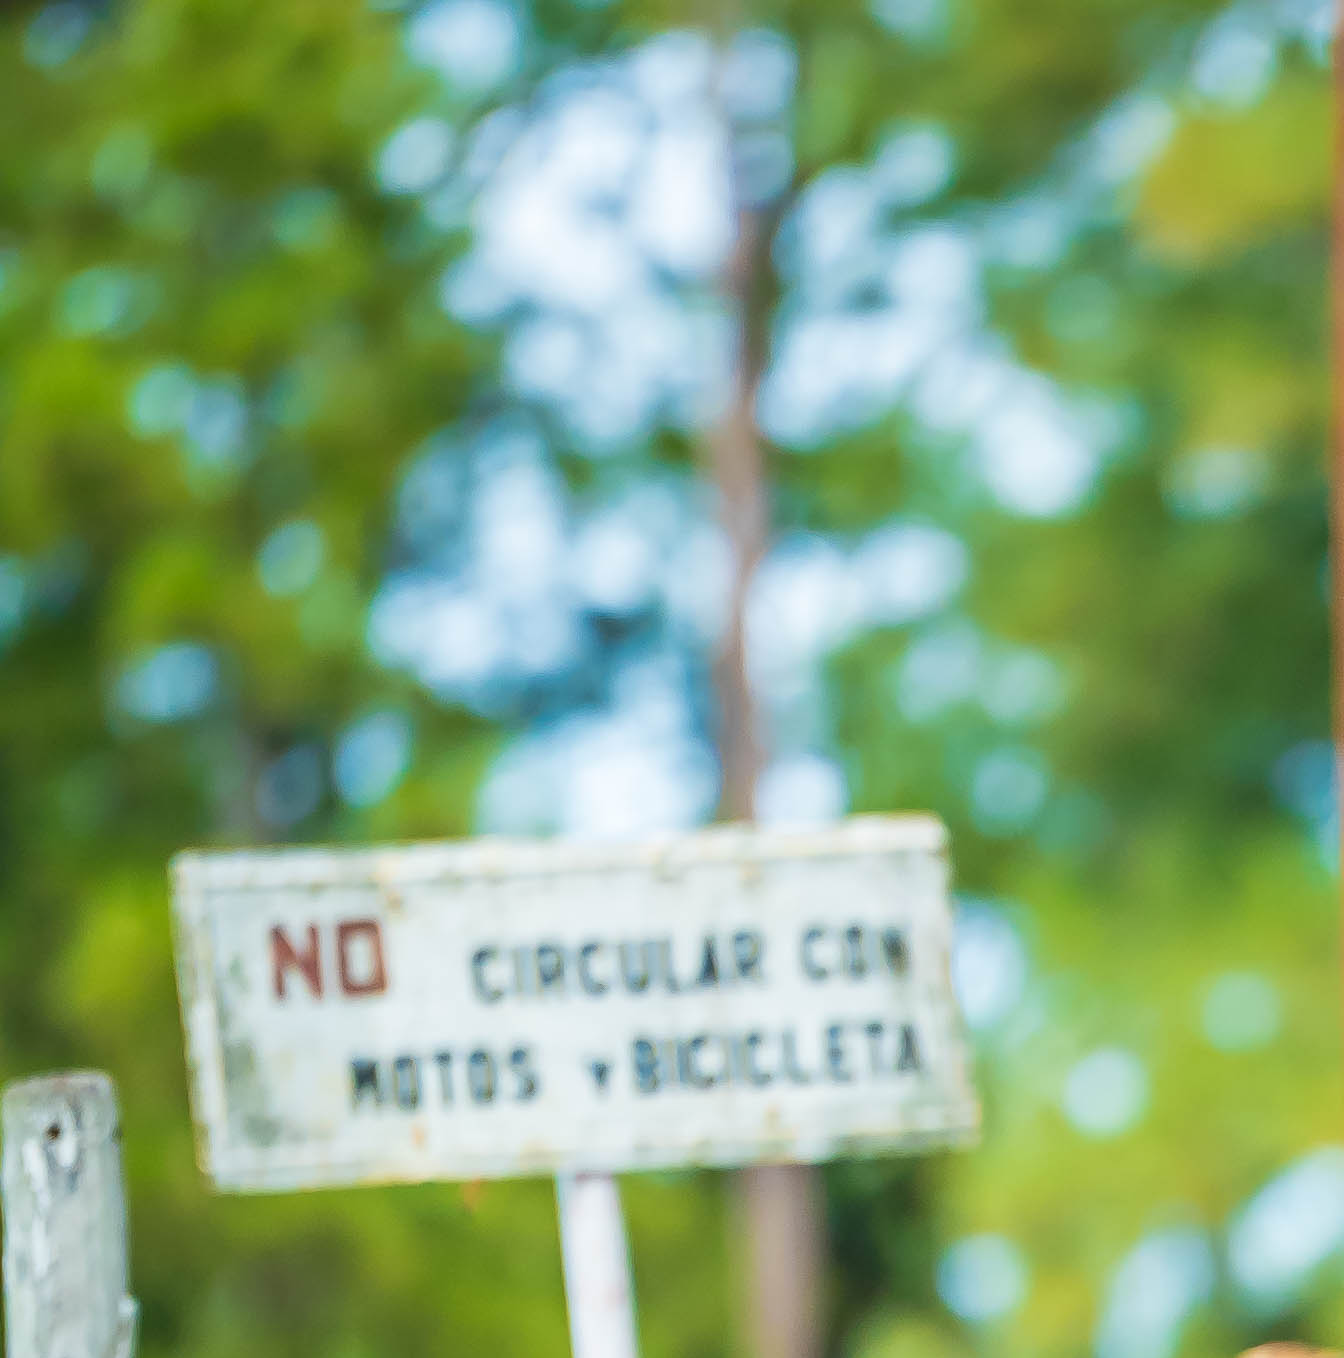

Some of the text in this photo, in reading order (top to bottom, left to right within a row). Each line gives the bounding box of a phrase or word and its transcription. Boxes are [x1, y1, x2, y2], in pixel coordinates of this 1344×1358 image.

[271, 919, 910, 1001] NO CIRCULAR CON
[350, 1048, 538, 1112] MOTOS
[633, 1022, 920, 1093] BICICLETA
